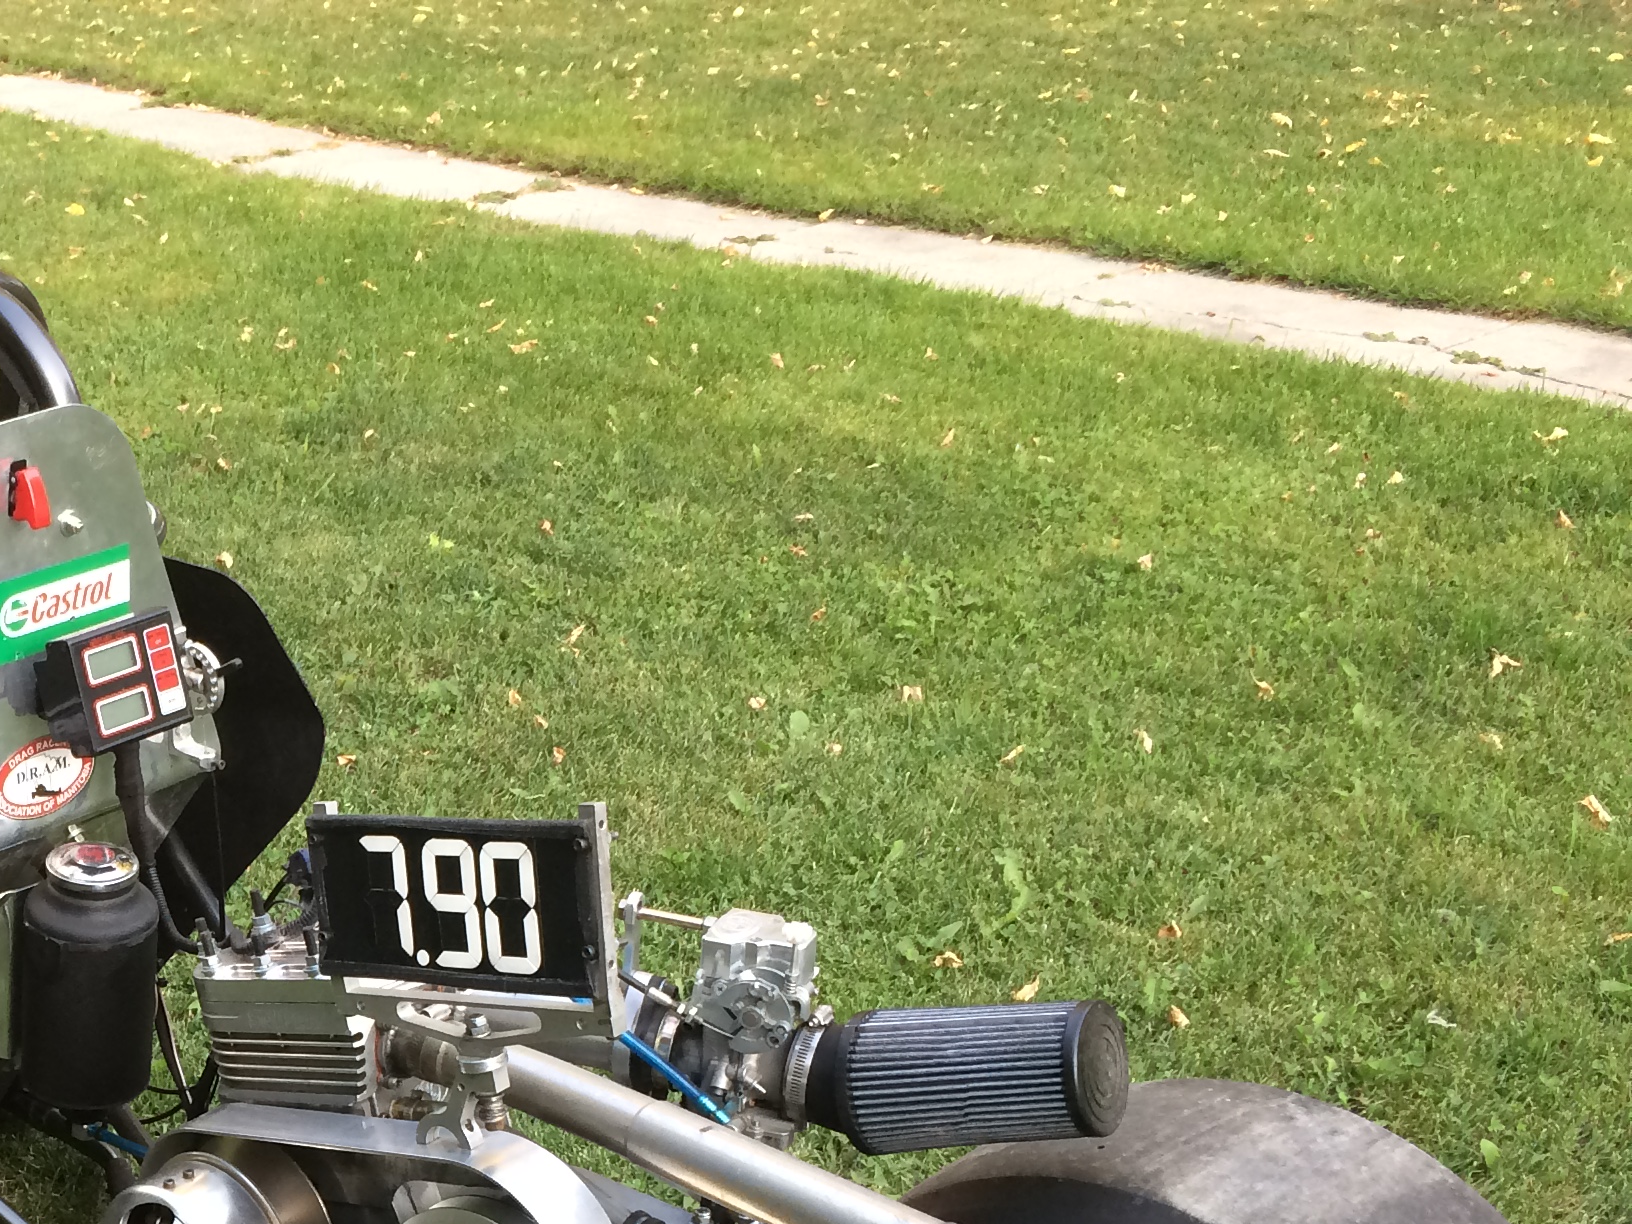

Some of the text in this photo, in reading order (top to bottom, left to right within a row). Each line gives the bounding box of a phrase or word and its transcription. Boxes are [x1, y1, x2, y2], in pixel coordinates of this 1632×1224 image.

[31, 571, 113, 624] Castrol
[9, 746, 35, 769] DRAG
[16, 756, 71, 785] D.R.A.M.
[43, 798, 55, 812] OF
[56, 762, 92, 805] MANITOBA
[358, 835, 542, 975] 7.90
